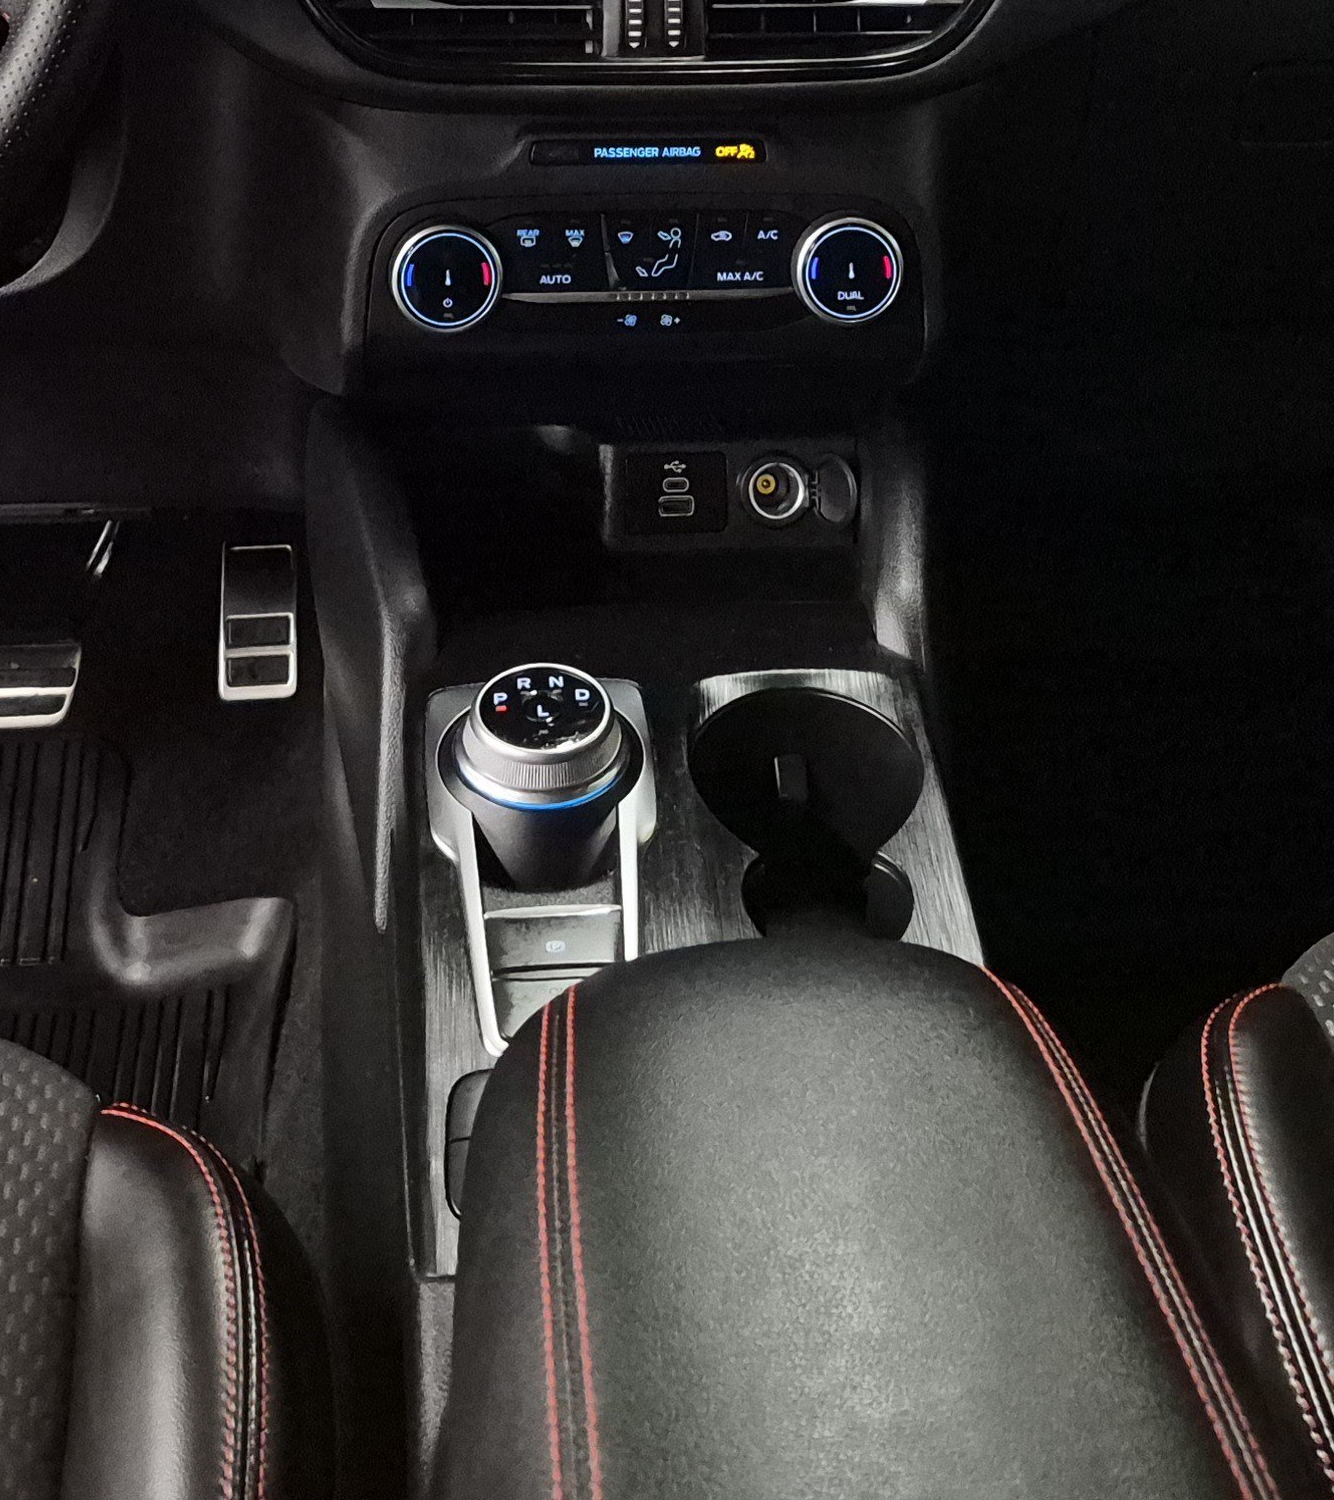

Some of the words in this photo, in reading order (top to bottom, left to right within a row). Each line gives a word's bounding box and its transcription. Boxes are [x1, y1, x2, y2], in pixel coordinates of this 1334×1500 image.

[593, 146, 659, 160] PASSENGER
[662, 146, 701, 160] AIRBAG
[715, 146, 738, 160] OFF
[565, 228, 585, 238] MAX
[757, 229, 779, 241] A/C
[539, 273, 571, 286] AUTO
[716, 270, 741, 283] MAX
[744, 270, 765, 284] A/C
[837, 289, 865, 302] DUAL
[517, 678, 531, 690] R
[548, 676, 564, 688] N
[493, 692, 508, 705] P
[575, 689, 590, 701] D
[536, 704, 549, 718] L
